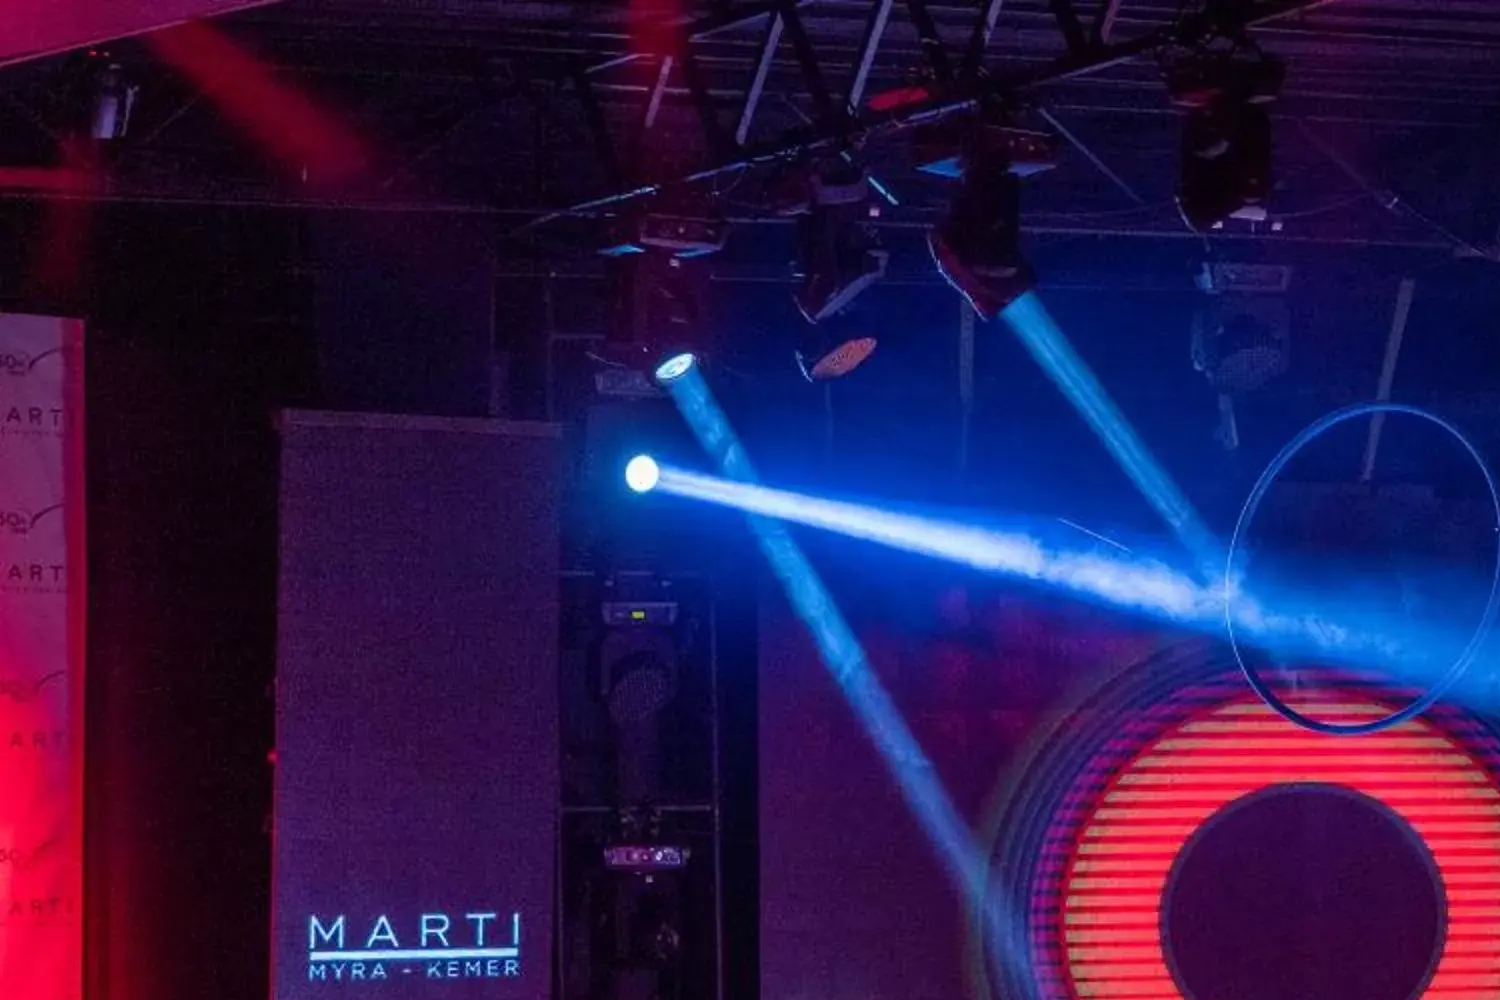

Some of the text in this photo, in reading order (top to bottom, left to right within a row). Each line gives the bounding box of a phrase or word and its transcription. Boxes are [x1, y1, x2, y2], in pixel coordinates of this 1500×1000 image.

[309, 912, 519, 949] MARTI
[309, 963, 388, 980] MYRA
[427, 960, 519, 978] KEMER
